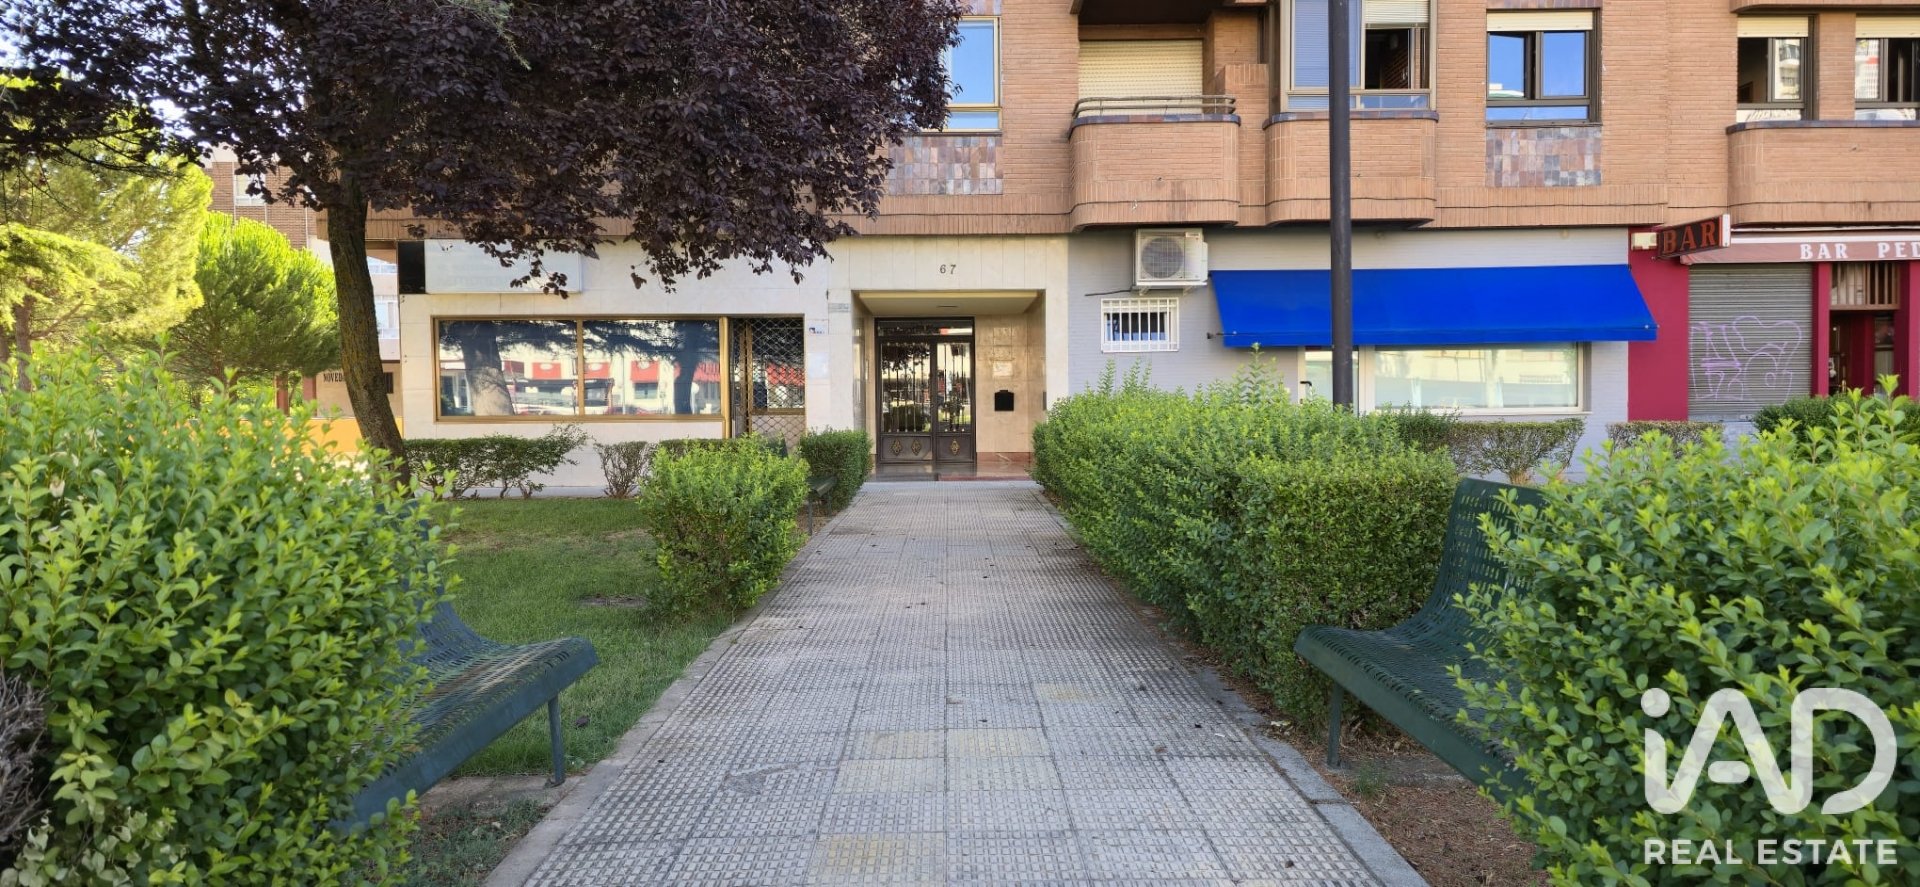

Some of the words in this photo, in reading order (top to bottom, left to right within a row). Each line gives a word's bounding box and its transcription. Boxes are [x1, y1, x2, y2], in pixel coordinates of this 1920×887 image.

[1663, 221, 1716, 254] BAR
[1800, 243, 1848, 260] BAR
[940, 264, 956, 275] 67
[323, 372, 345, 382] NOVED
